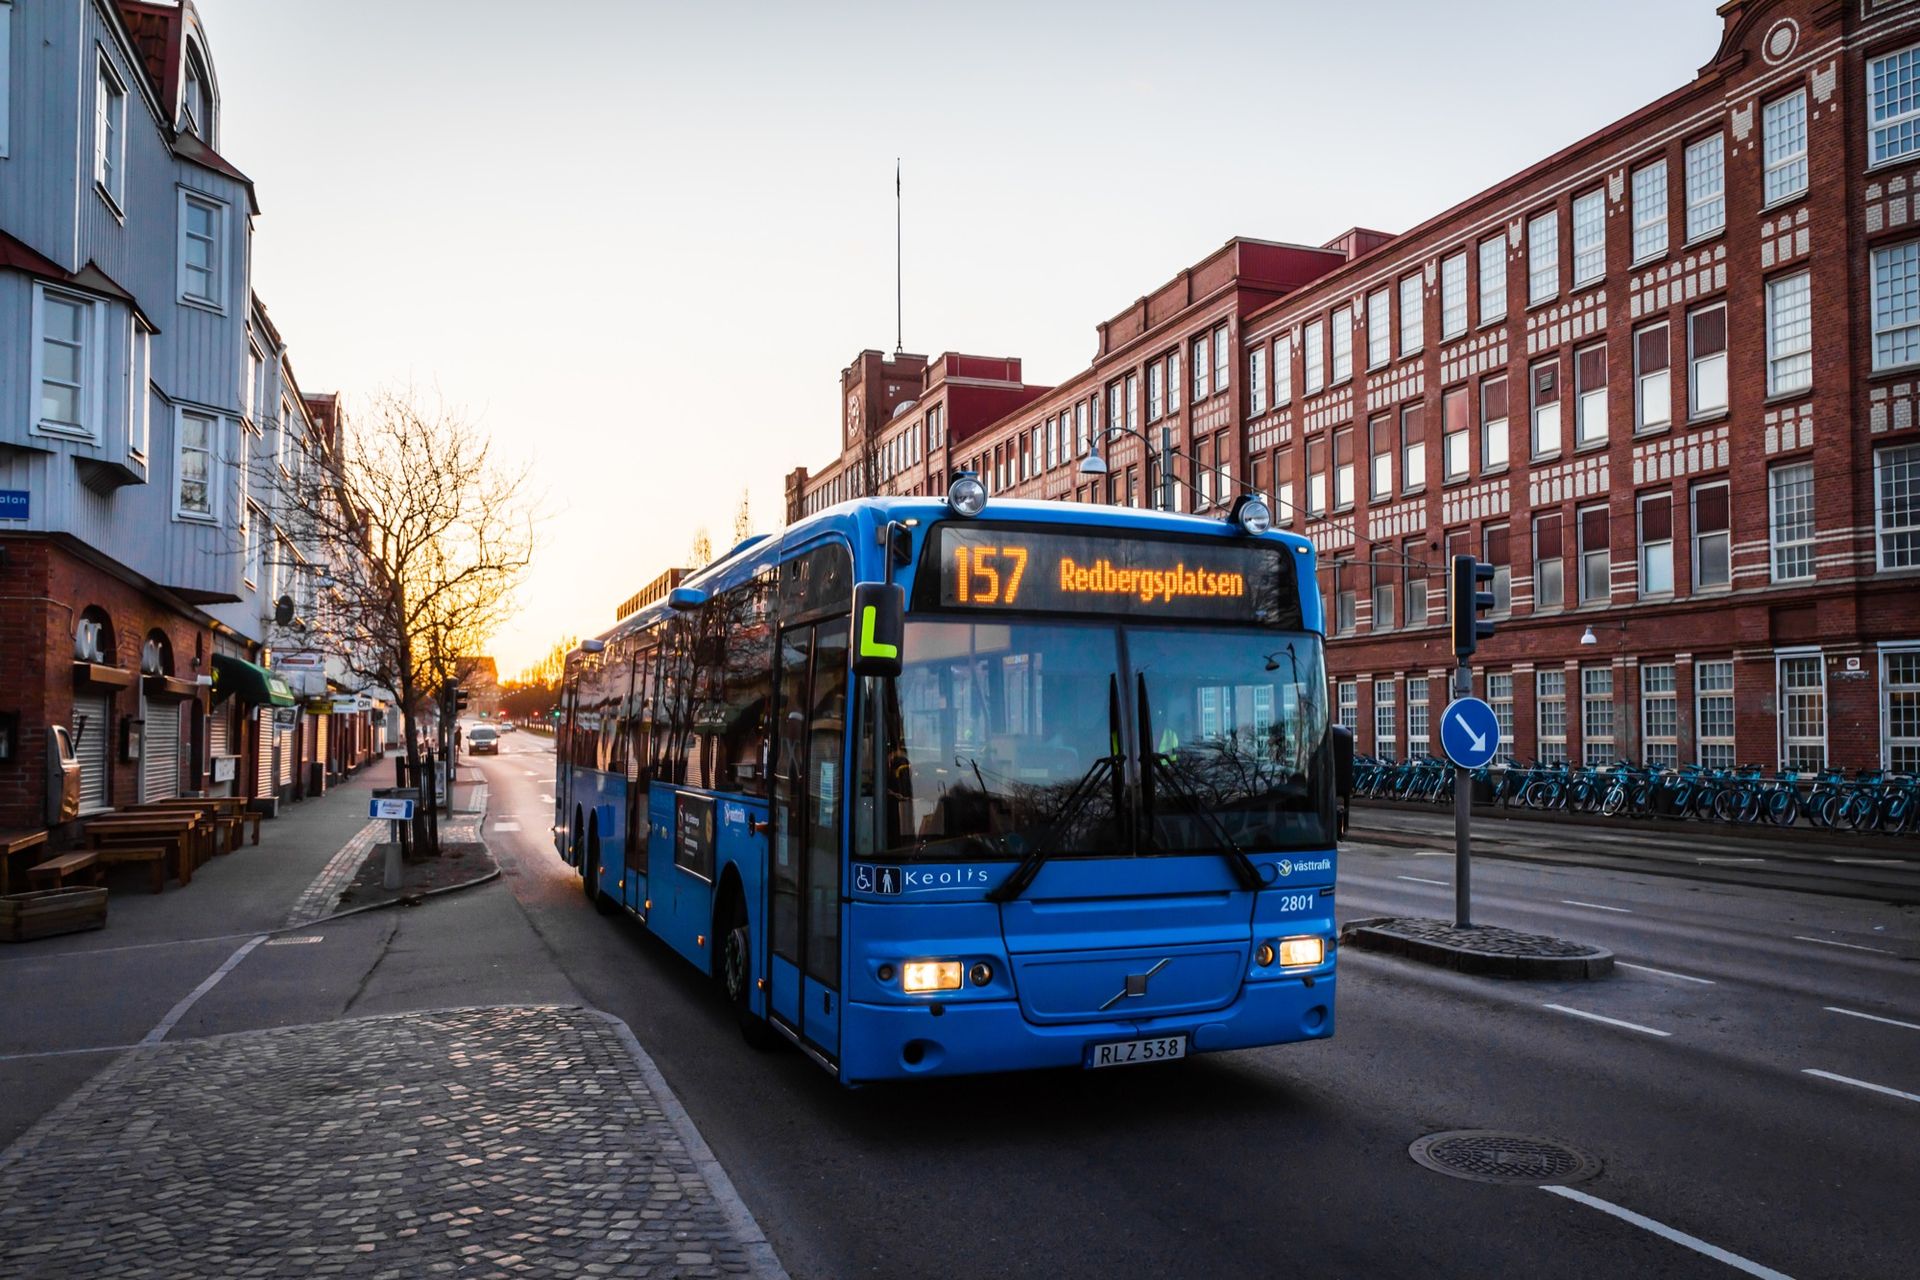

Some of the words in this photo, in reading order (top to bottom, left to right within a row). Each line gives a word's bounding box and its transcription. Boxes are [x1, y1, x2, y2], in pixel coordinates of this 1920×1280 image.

[954, 546, 1028, 604] 157
[1060, 558, 1244, 603] Redbergsplatsen
[1293, 858, 1332, 872] västtrafik
[905, 868, 988, 885] Keolis
[1280, 894, 1313, 912] 2801
[1101, 1044, 1136, 1064] RLZ
[1143, 1039, 1178, 1059] 538
